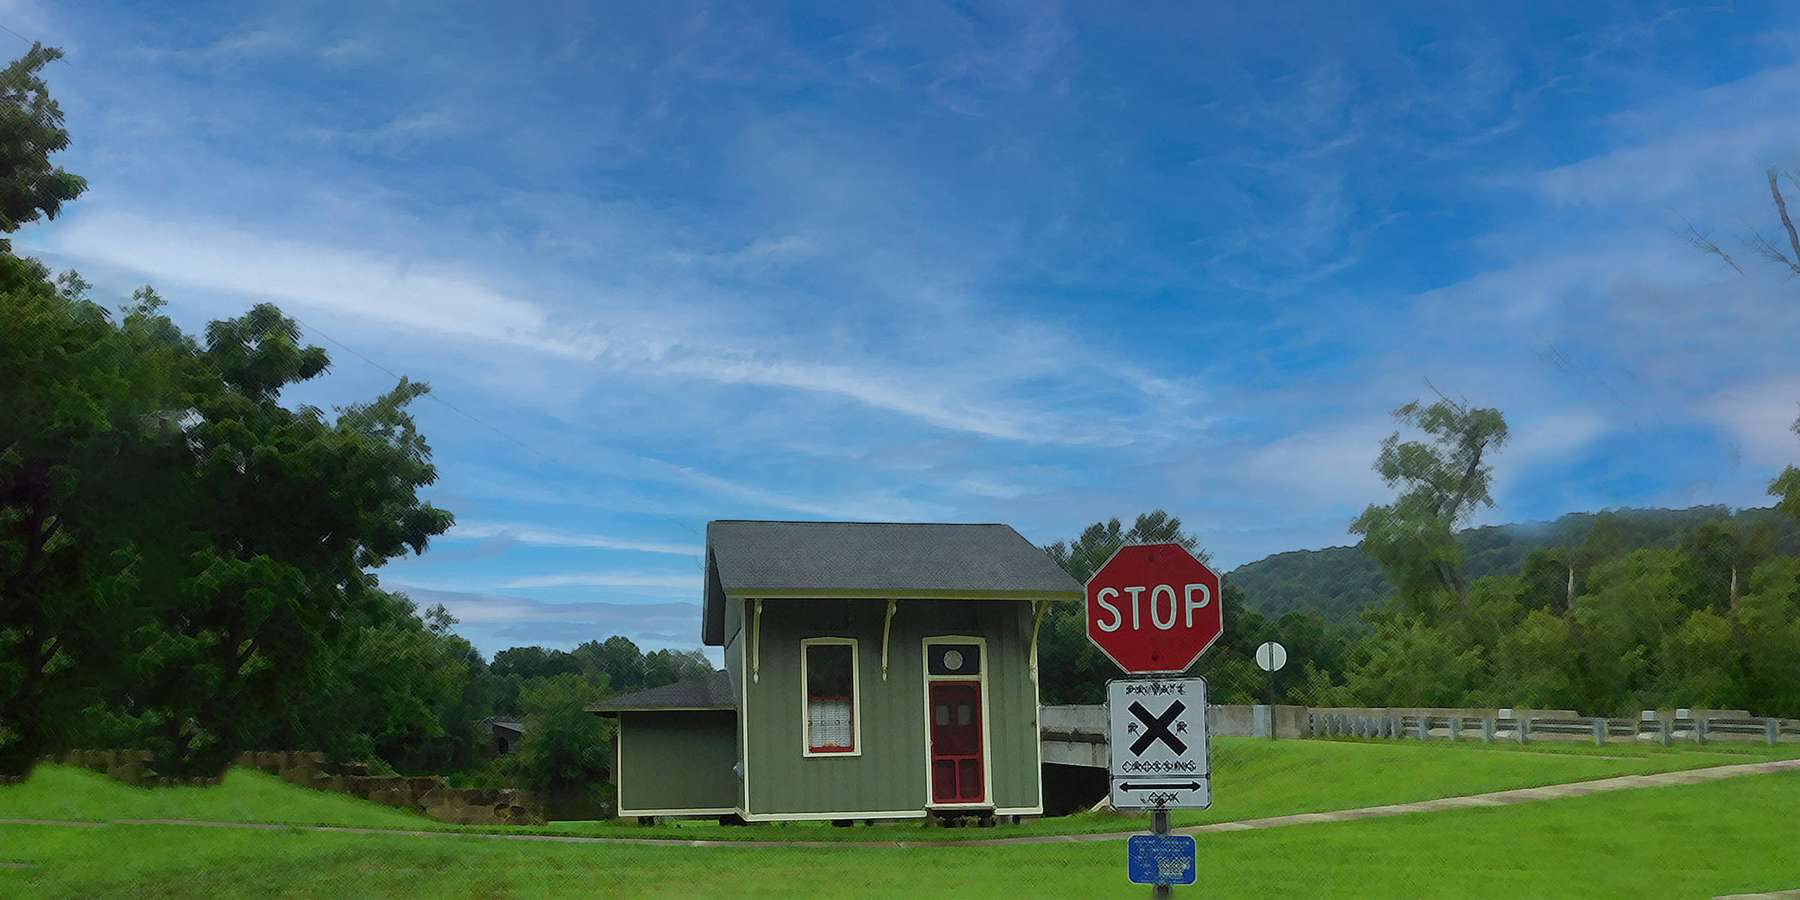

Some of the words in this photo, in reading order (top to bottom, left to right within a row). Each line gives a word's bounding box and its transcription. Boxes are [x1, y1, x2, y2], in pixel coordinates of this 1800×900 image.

[1096, 583, 1211, 633] STOP
[1127, 721, 1140, 736] R
[1175, 720, 1188, 736] R
